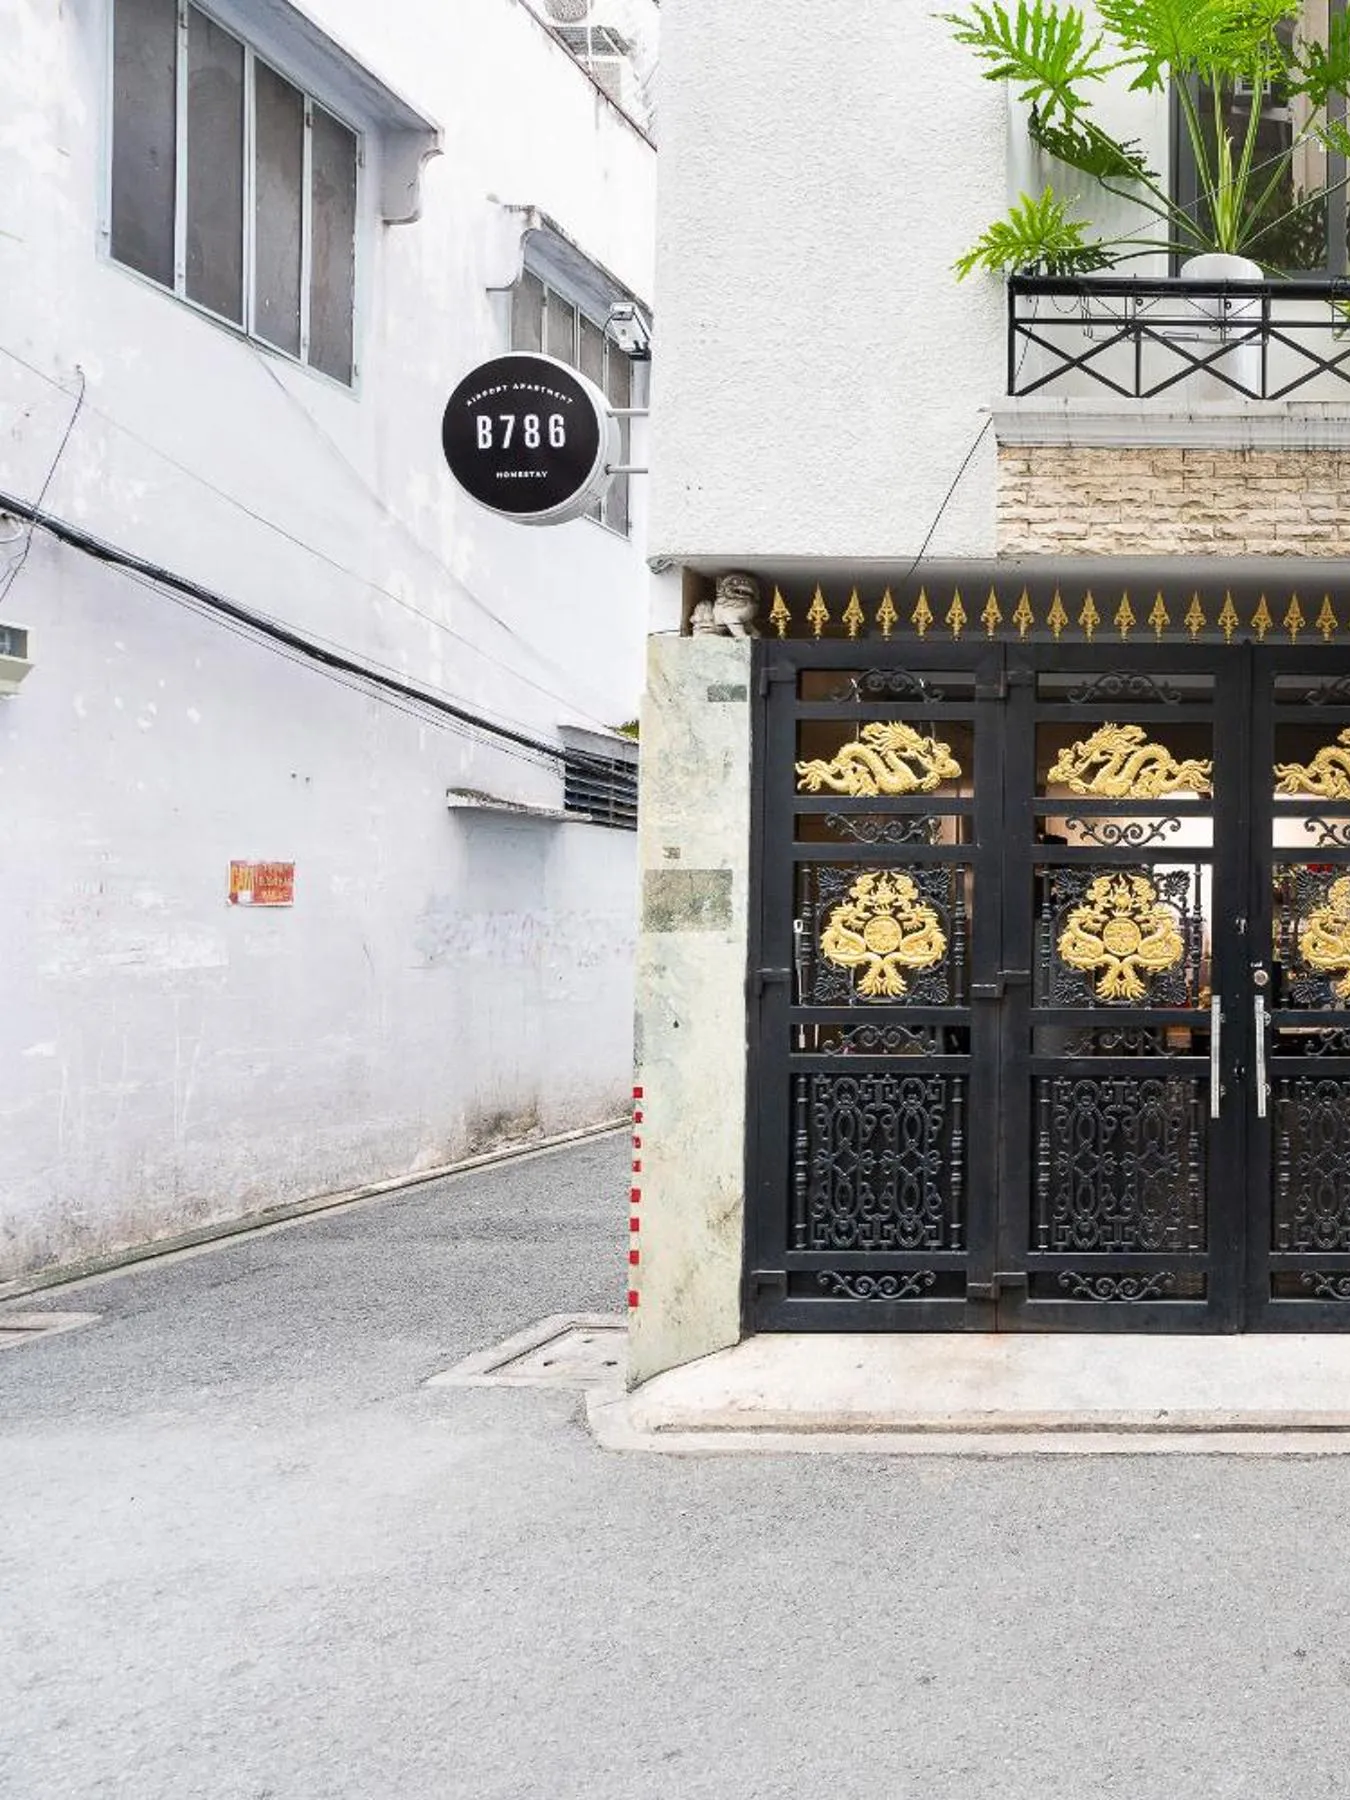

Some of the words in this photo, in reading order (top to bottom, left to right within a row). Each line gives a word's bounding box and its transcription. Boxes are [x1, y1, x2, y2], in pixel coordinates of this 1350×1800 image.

[467, 384, 508, 407] AIRPORT
[512, 382, 573, 404] APARTMENT
[476, 413, 566, 449] B786
[496, 470, 548, 479] HOMESTAY
